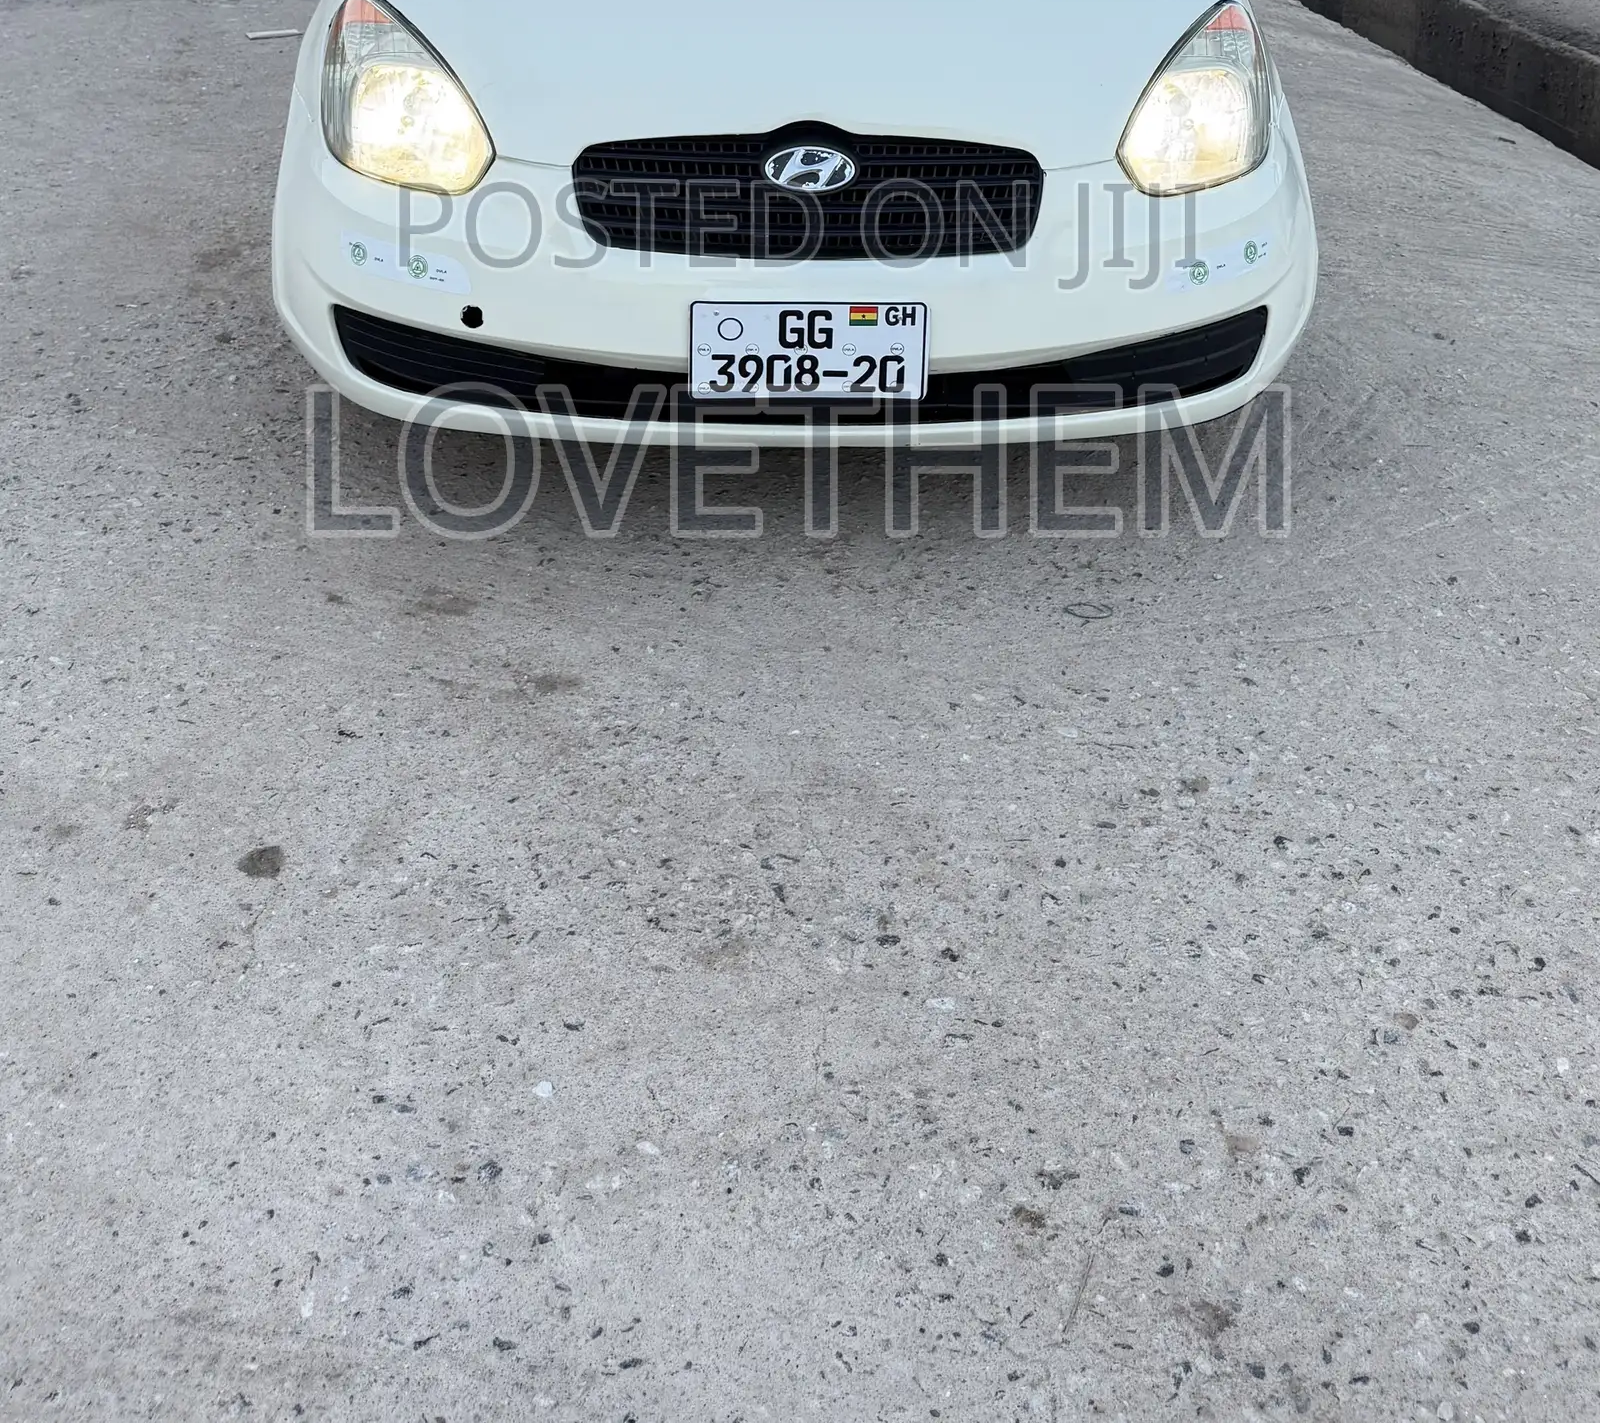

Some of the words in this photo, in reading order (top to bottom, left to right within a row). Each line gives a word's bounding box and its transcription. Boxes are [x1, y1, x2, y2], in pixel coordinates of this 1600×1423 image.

[779, 310, 834, 349] GG
[884, 306, 917, 327] GH
[709, 354, 905, 393] 3908-20
